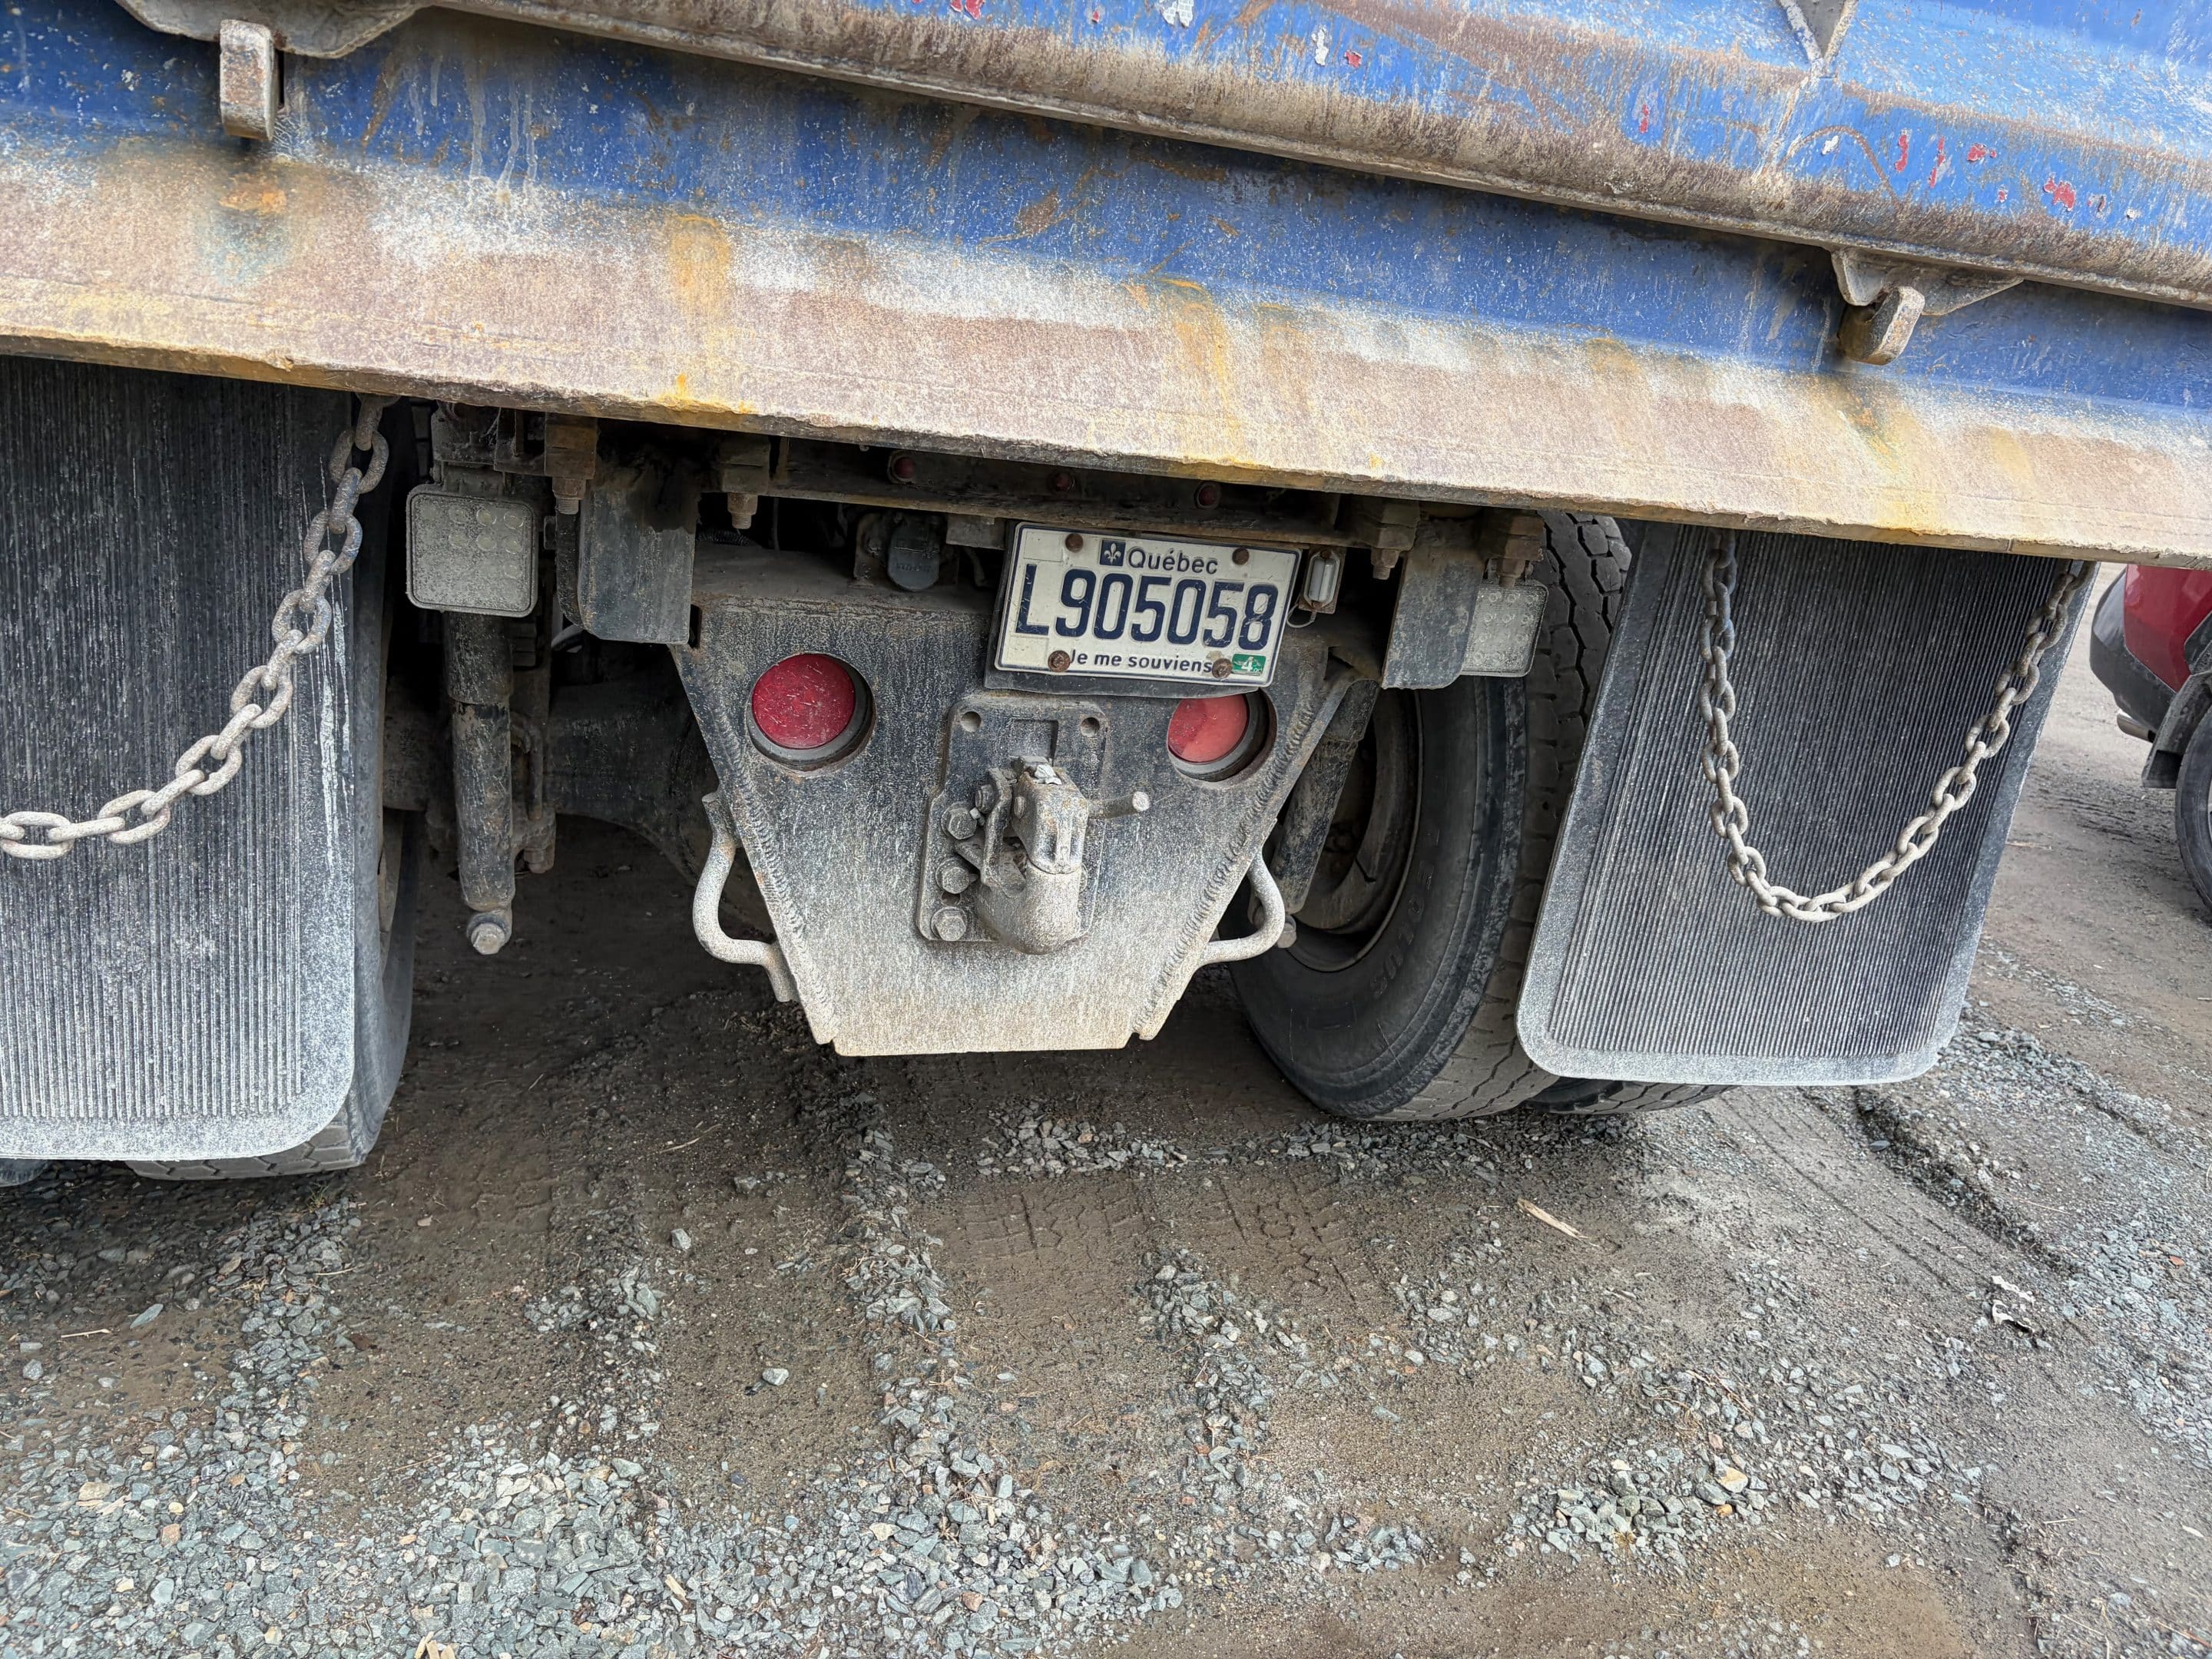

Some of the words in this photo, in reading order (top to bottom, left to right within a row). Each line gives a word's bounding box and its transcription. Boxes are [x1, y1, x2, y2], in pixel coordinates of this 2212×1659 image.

[1128, 548, 1218, 575] Québec
[1015, 563, 1279, 651] L905058
[1070, 649, 1088, 665] Je
[1094, 654, 1122, 667] me
[1128, 654, 1214, 673] souviens
